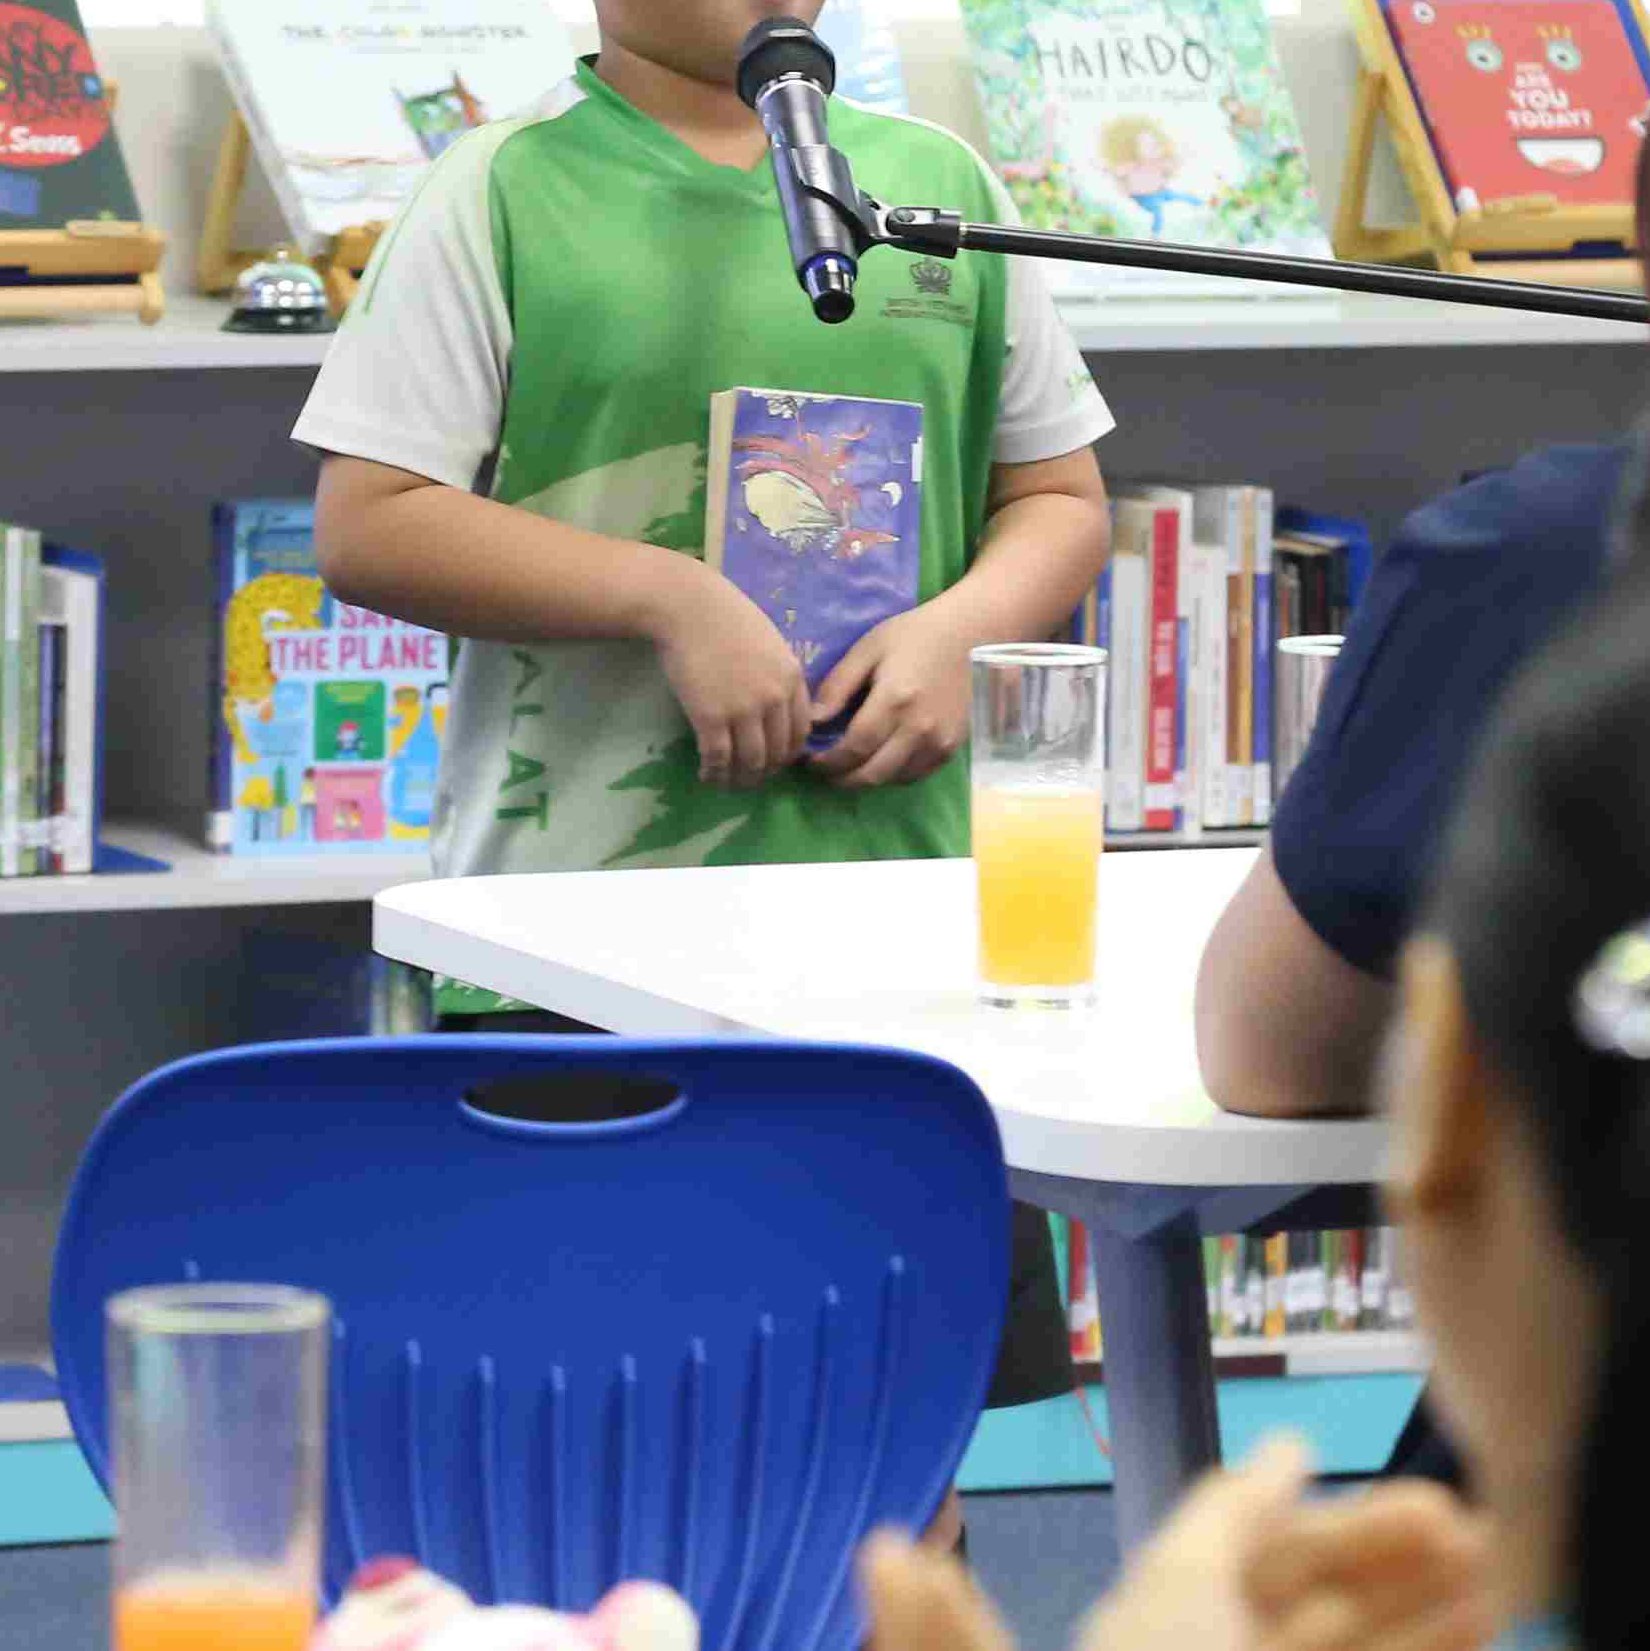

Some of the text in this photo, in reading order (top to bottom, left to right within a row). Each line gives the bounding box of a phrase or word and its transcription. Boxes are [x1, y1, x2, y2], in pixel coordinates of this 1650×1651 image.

[1035, 33, 1214, 83] HAIRDO
[275, 635, 439, 671] THE PLANE
